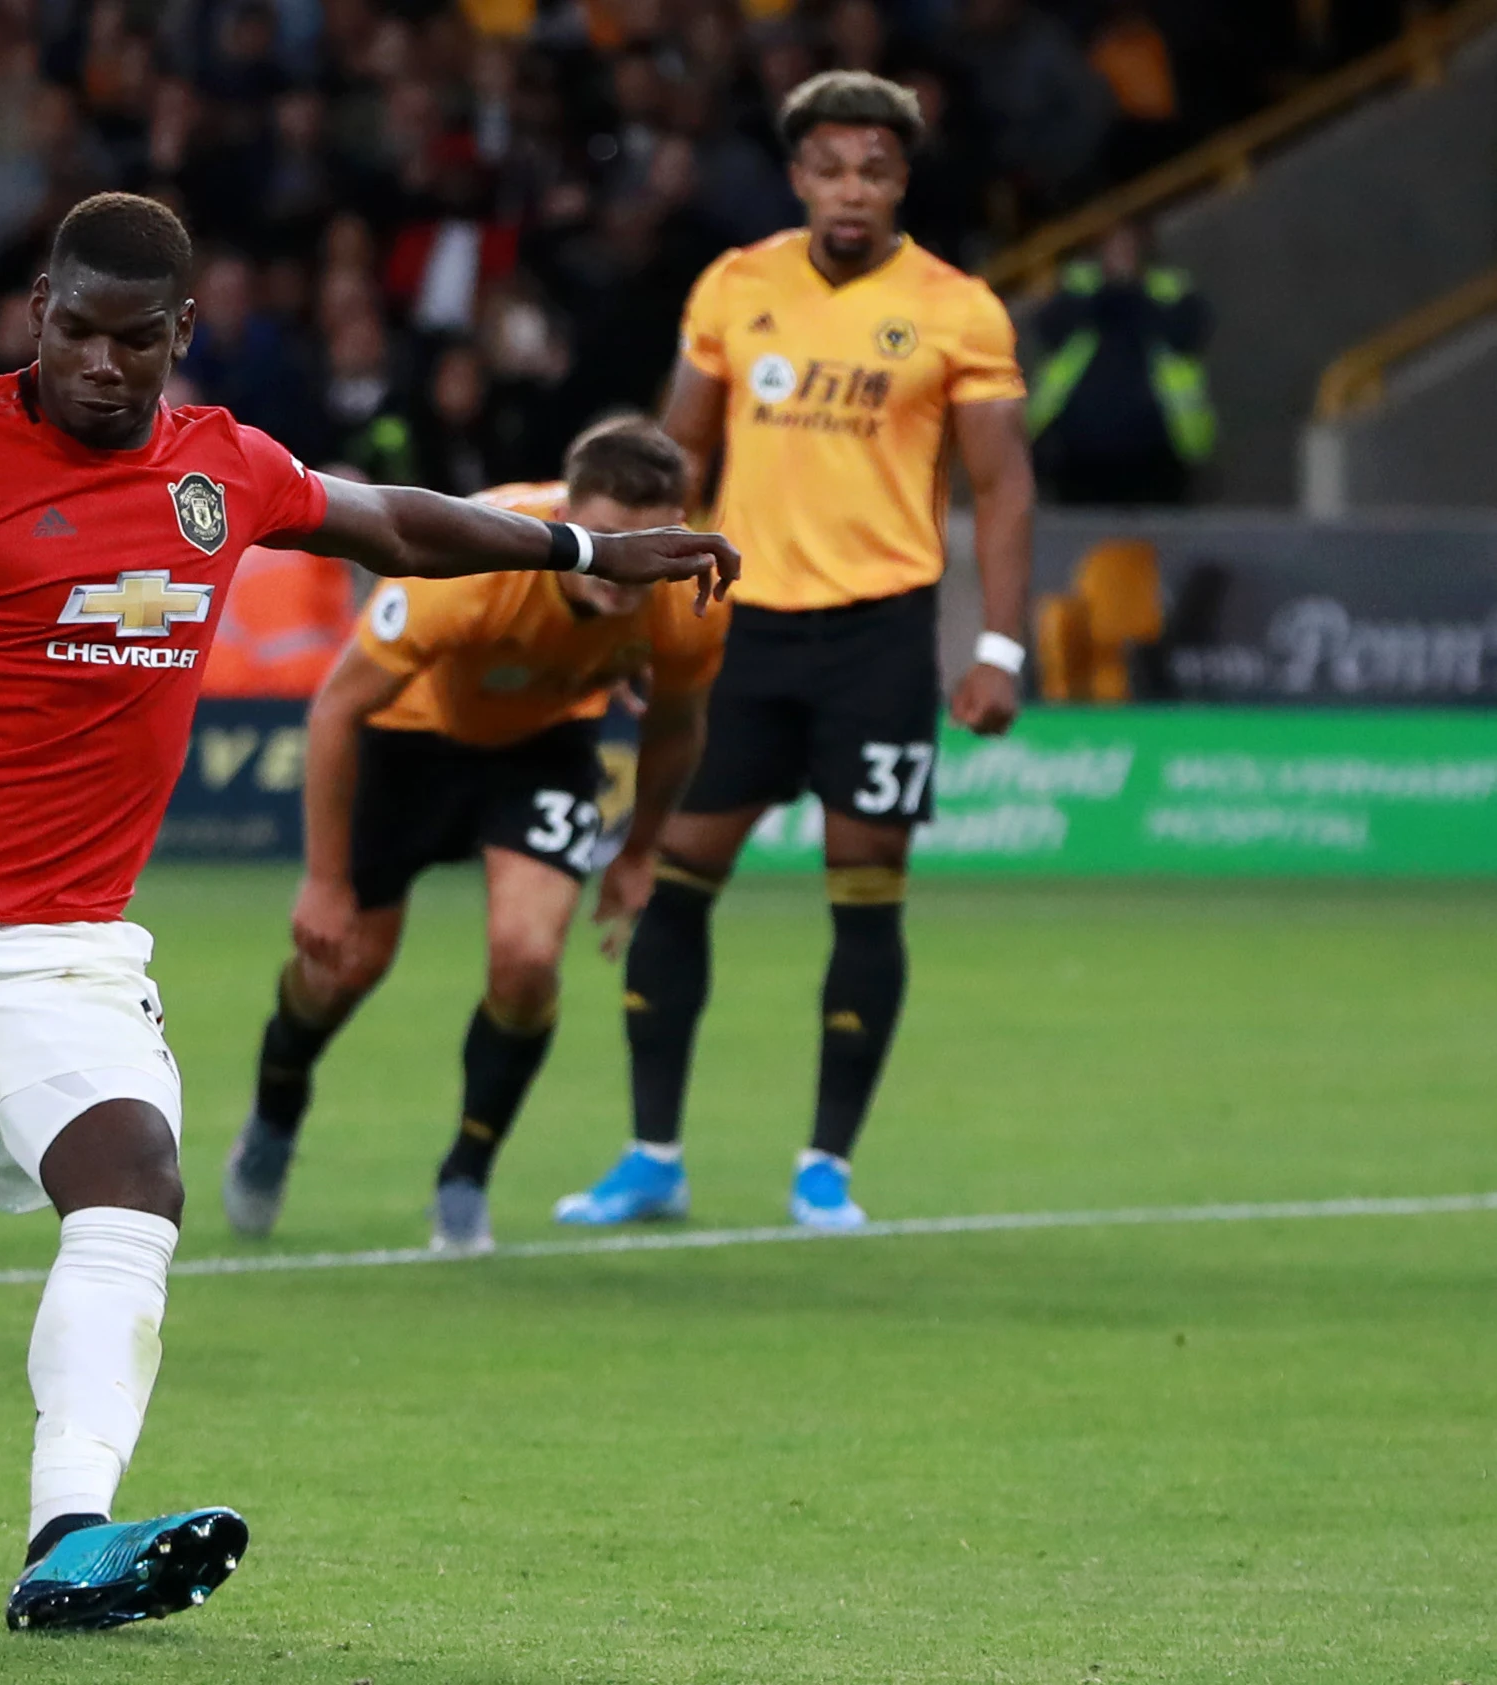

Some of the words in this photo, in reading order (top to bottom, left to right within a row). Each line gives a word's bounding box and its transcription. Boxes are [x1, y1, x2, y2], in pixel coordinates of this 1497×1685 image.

[47, 641, 199, 669] CHEVROLET
[852, 742, 934, 815] 37
[934, 737, 1135, 800] uffield
[526, 789, 599, 872] 32
